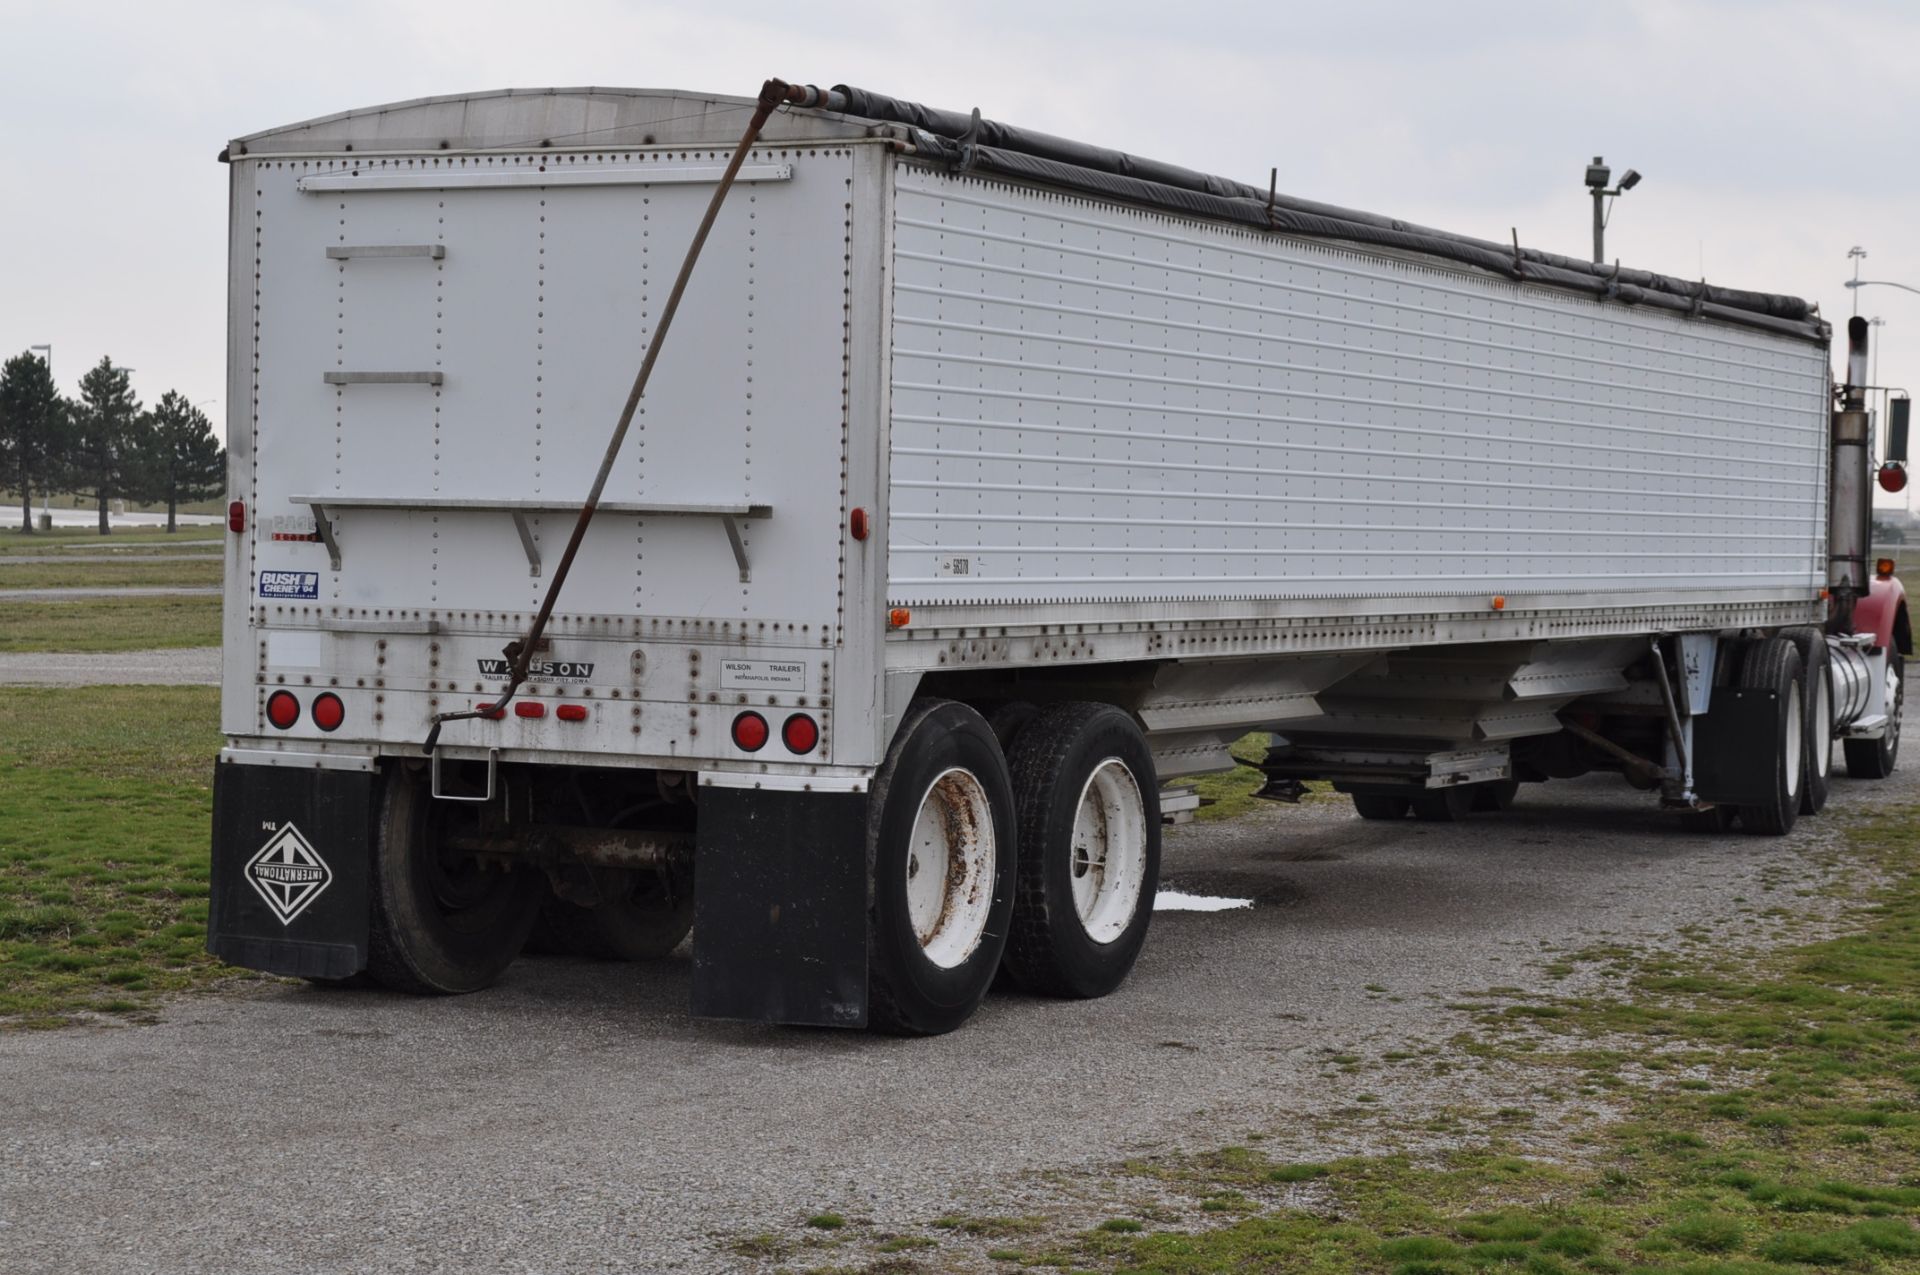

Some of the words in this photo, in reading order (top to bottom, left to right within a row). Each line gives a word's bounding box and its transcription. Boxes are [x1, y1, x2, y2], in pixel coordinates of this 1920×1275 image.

[261, 573, 300, 585] BUSH
[264, 585, 300, 593] CHENEY
[482, 661, 588, 676] WISON
[262, 821, 276, 831] TM
[255, 866, 322, 881] INTERNATIONAL
